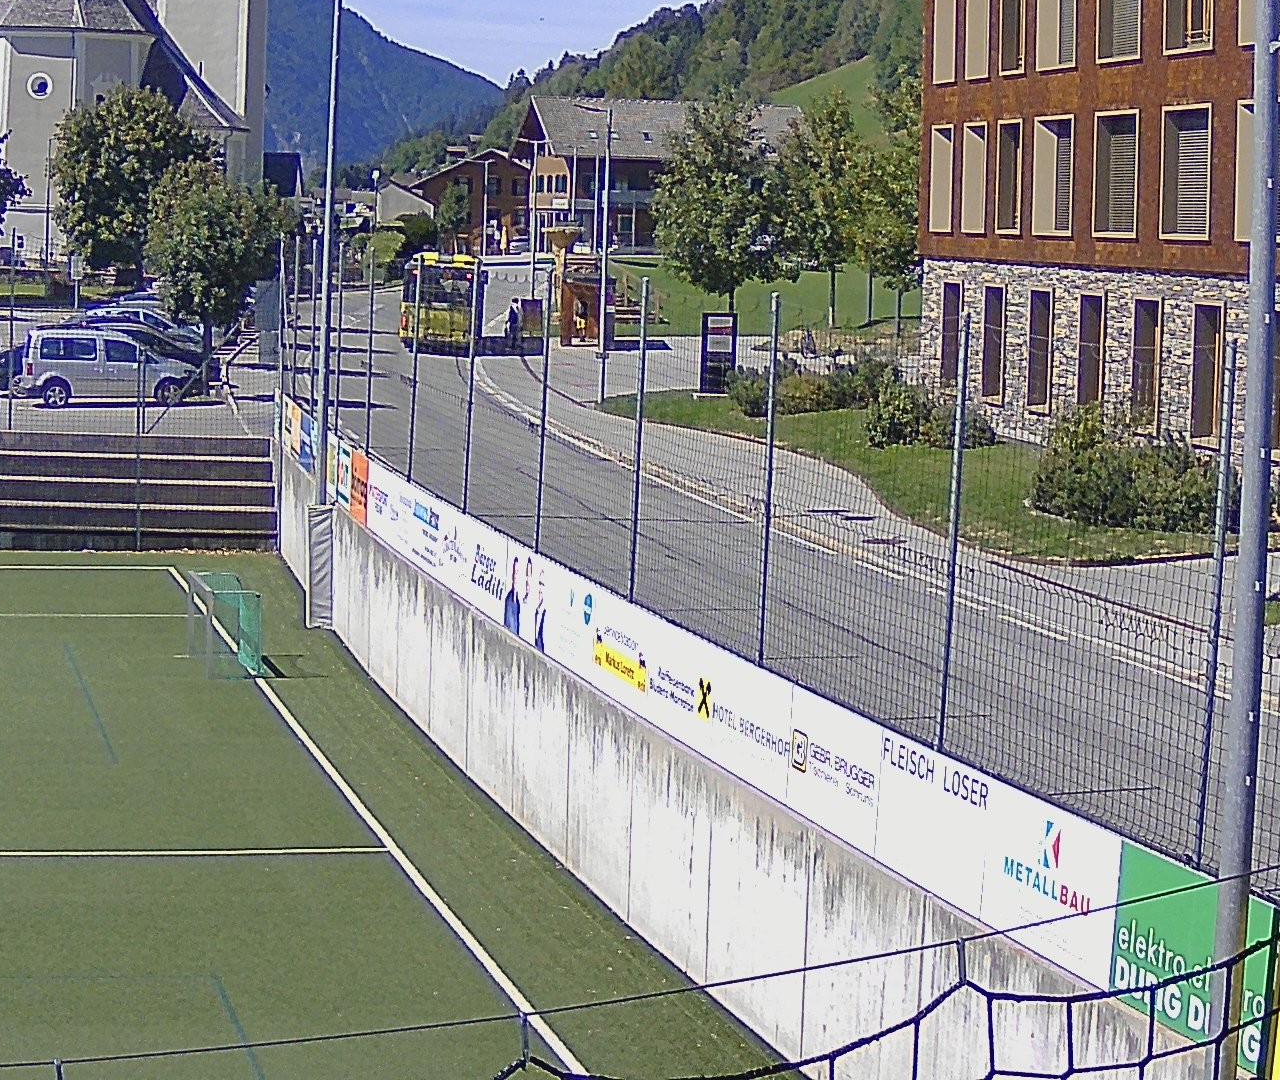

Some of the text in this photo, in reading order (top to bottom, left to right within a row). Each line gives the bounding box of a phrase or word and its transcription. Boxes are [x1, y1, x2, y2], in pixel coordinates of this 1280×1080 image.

[712, 702, 791, 758] HOTEL BERGERHOF
[882, 737, 989, 811] FLEISCH LOSER
[1003, 856, 1091, 916] METALLBAU
[1117, 918, 1186, 976] elektro
